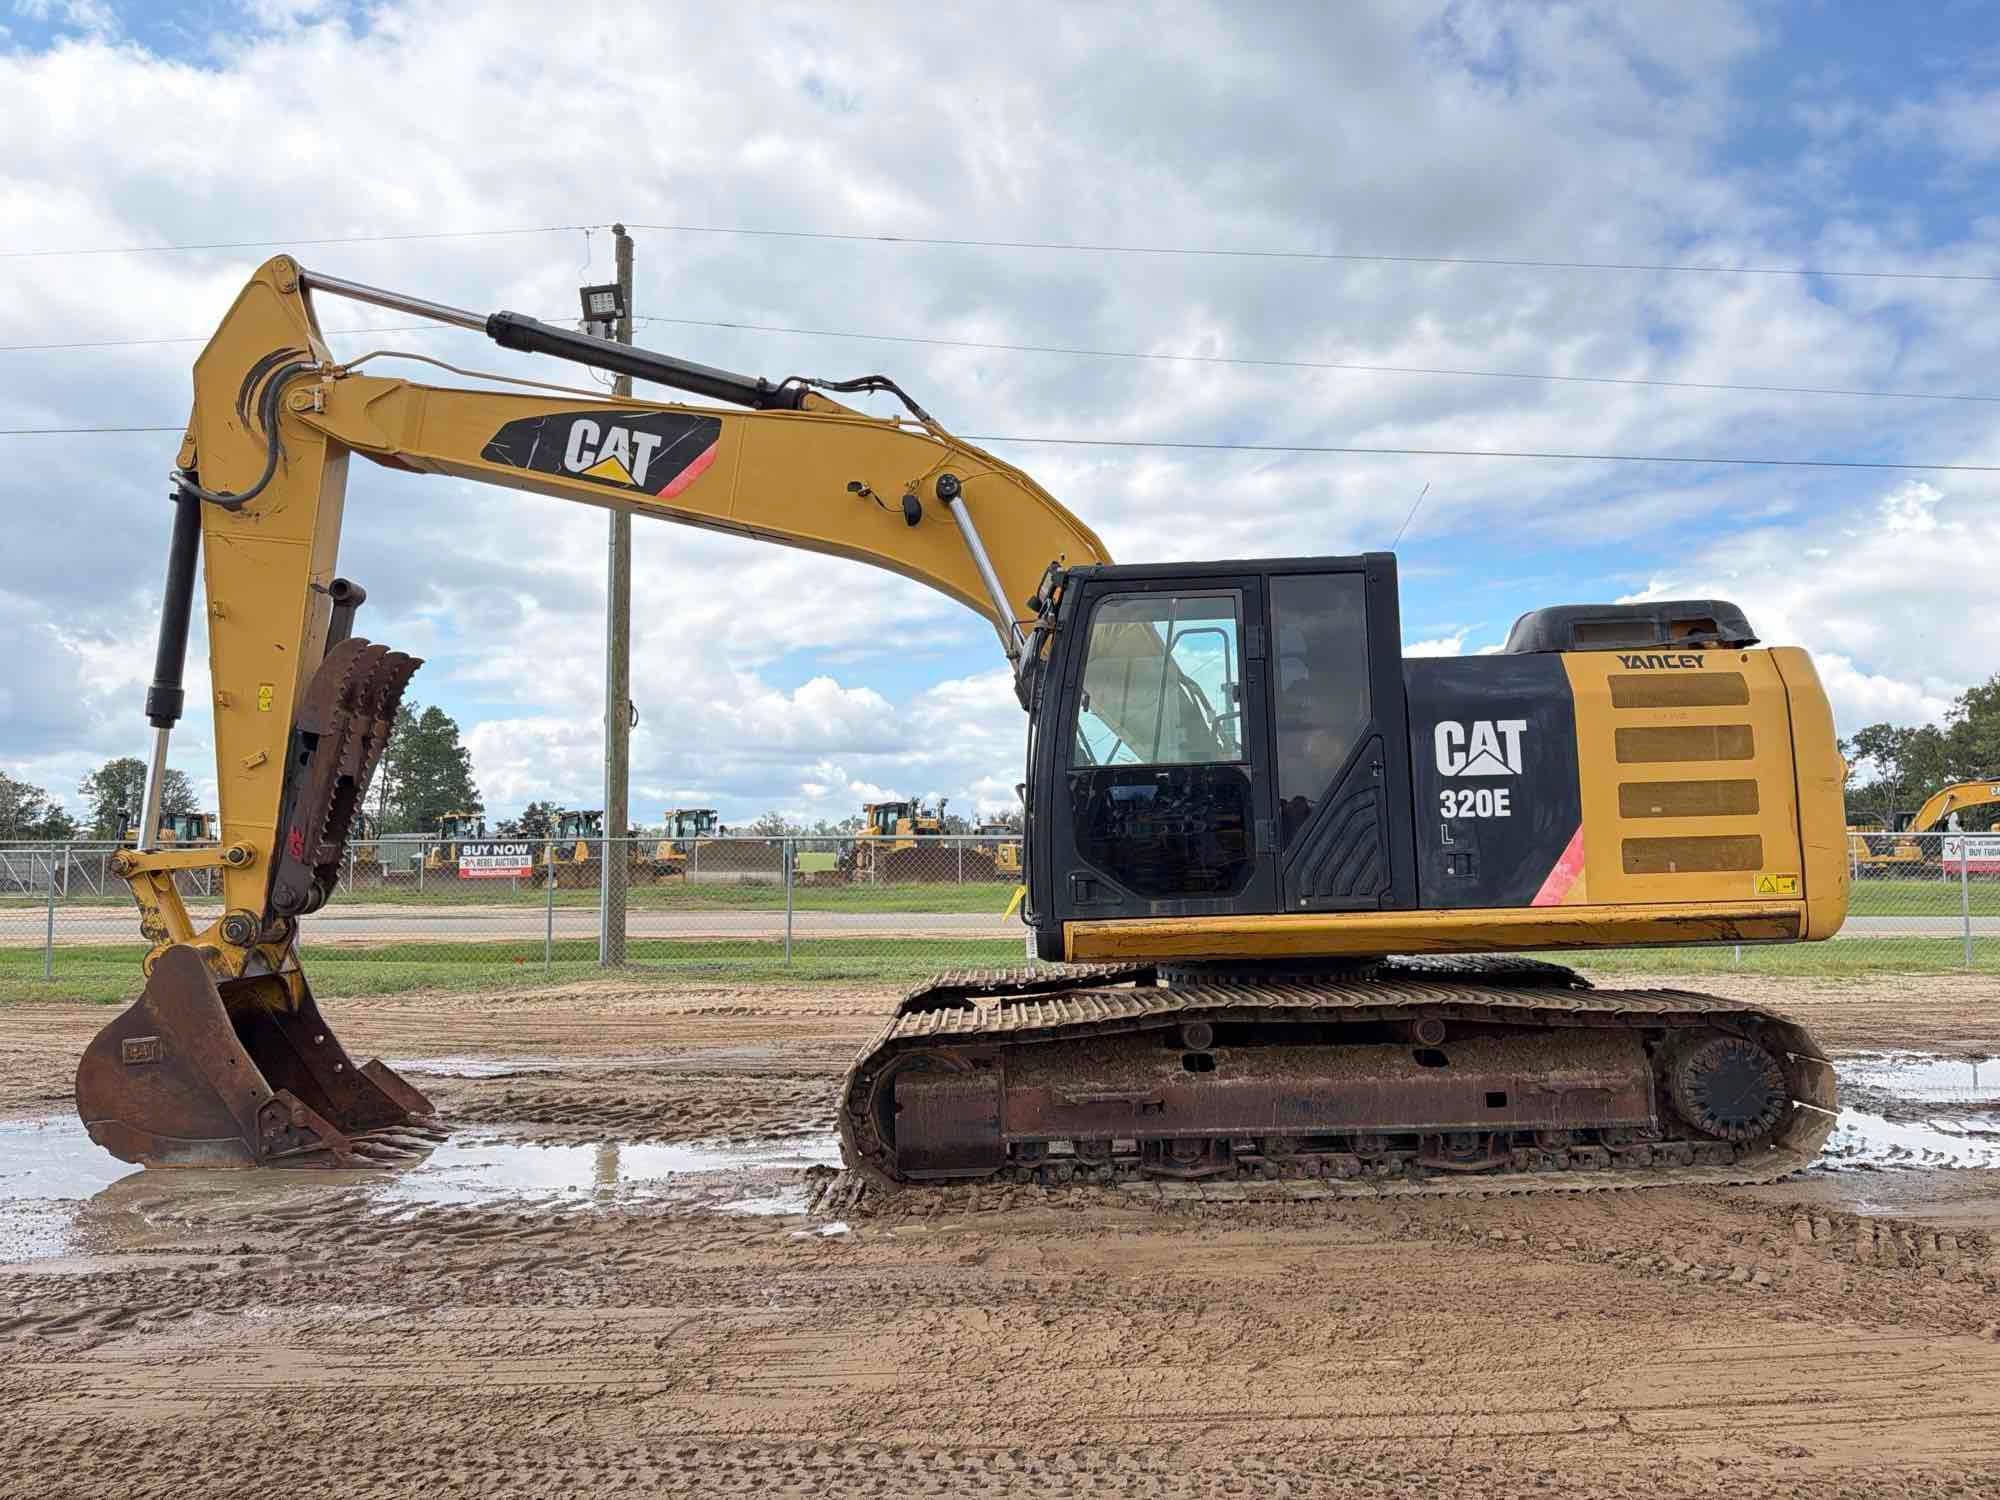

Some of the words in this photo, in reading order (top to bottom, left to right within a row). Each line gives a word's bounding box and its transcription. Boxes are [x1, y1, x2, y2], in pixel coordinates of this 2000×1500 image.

[564, 419, 662, 487] CAT
[1616, 655, 1704, 669] YANCEY
[1435, 719, 1527, 776] CAT
[1440, 788, 1511, 818] 320E
[1440, 823, 1454, 844] L
[463, 844, 489, 855] BUY
[493, 843, 528, 855] NOW
[477, 857, 493, 867] REBEL
[495, 857, 519, 866] AUCTION
